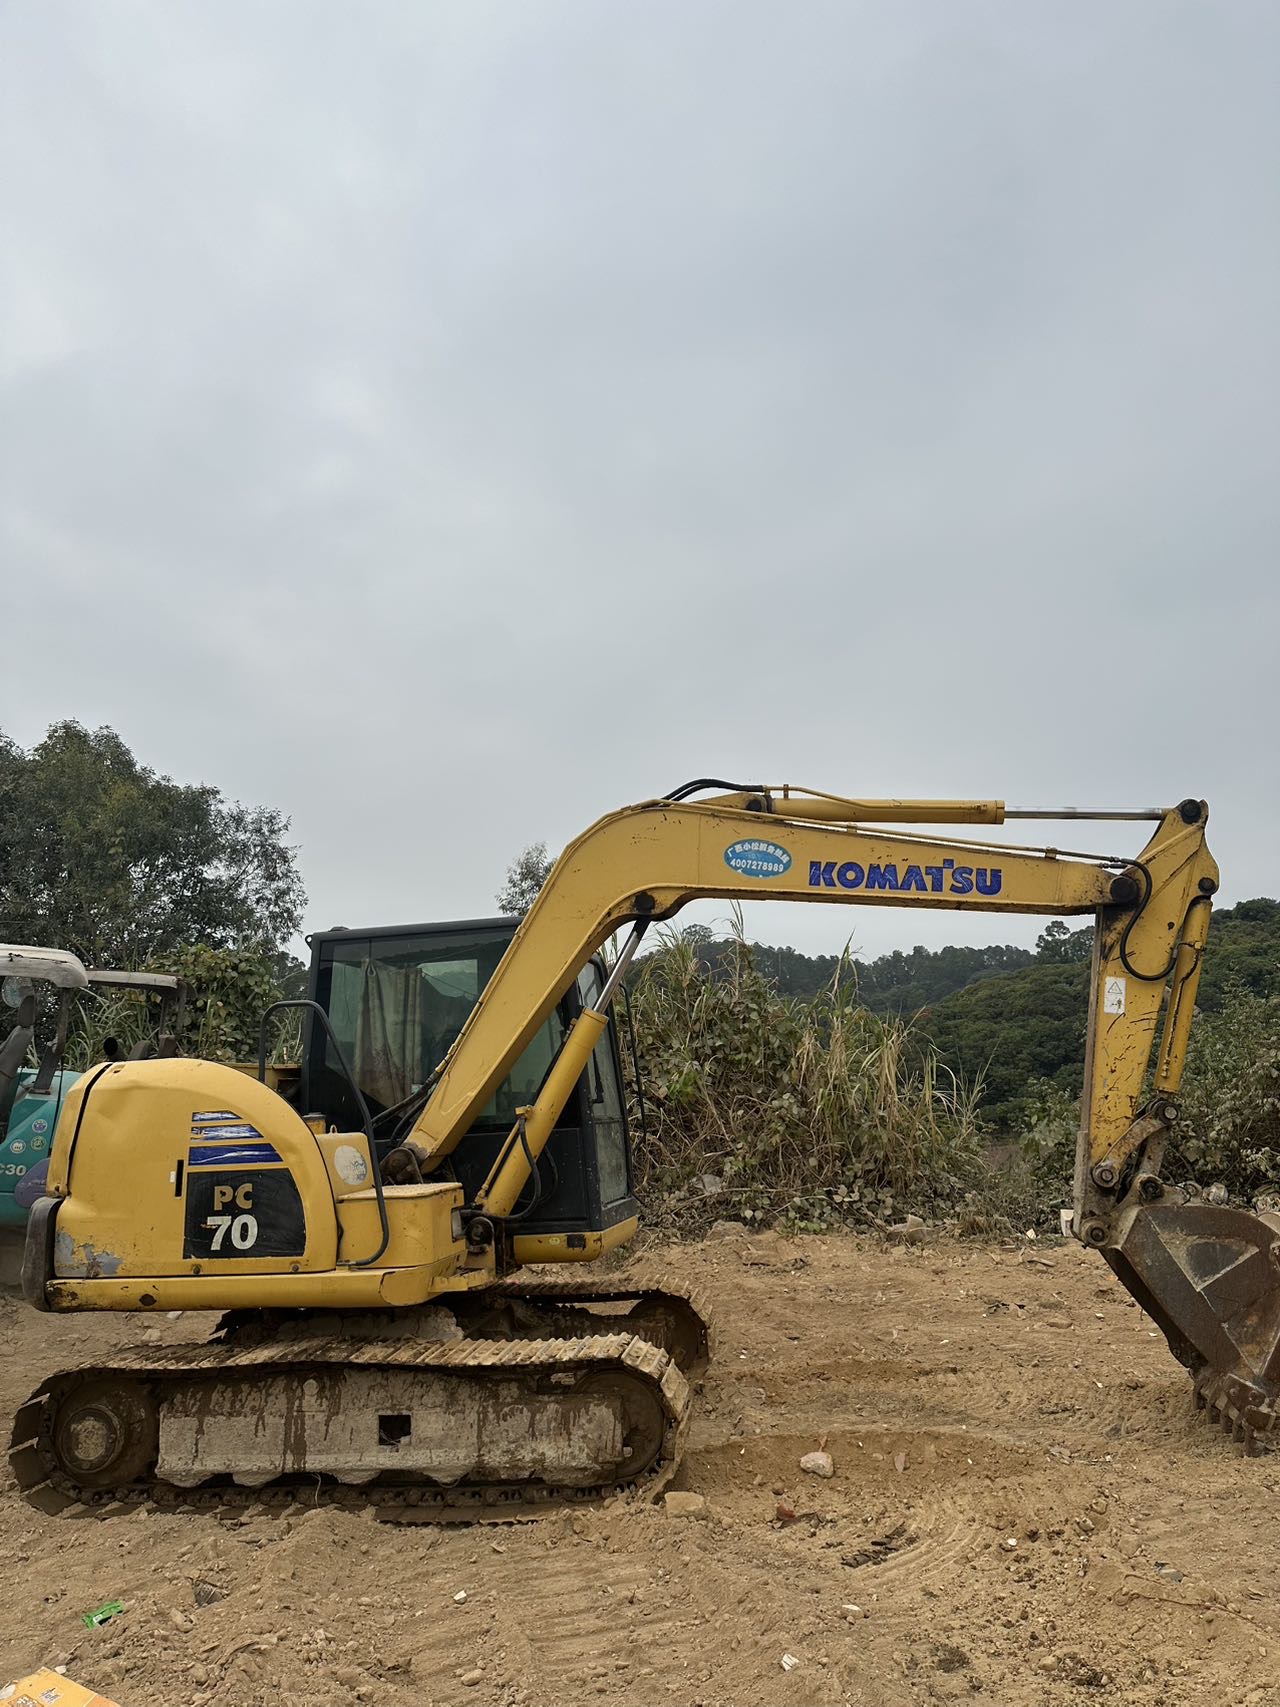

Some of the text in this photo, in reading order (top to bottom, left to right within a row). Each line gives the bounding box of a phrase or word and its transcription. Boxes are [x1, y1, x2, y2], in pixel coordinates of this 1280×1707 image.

[727, 842, 790, 863] 广西小松服务热线
[730, 859, 784, 872] 4007278989
[809, 858, 1002, 896] KOMATSU
[213, 1183, 253, 1211] PC
[206, 1214, 258, 1251] 70
